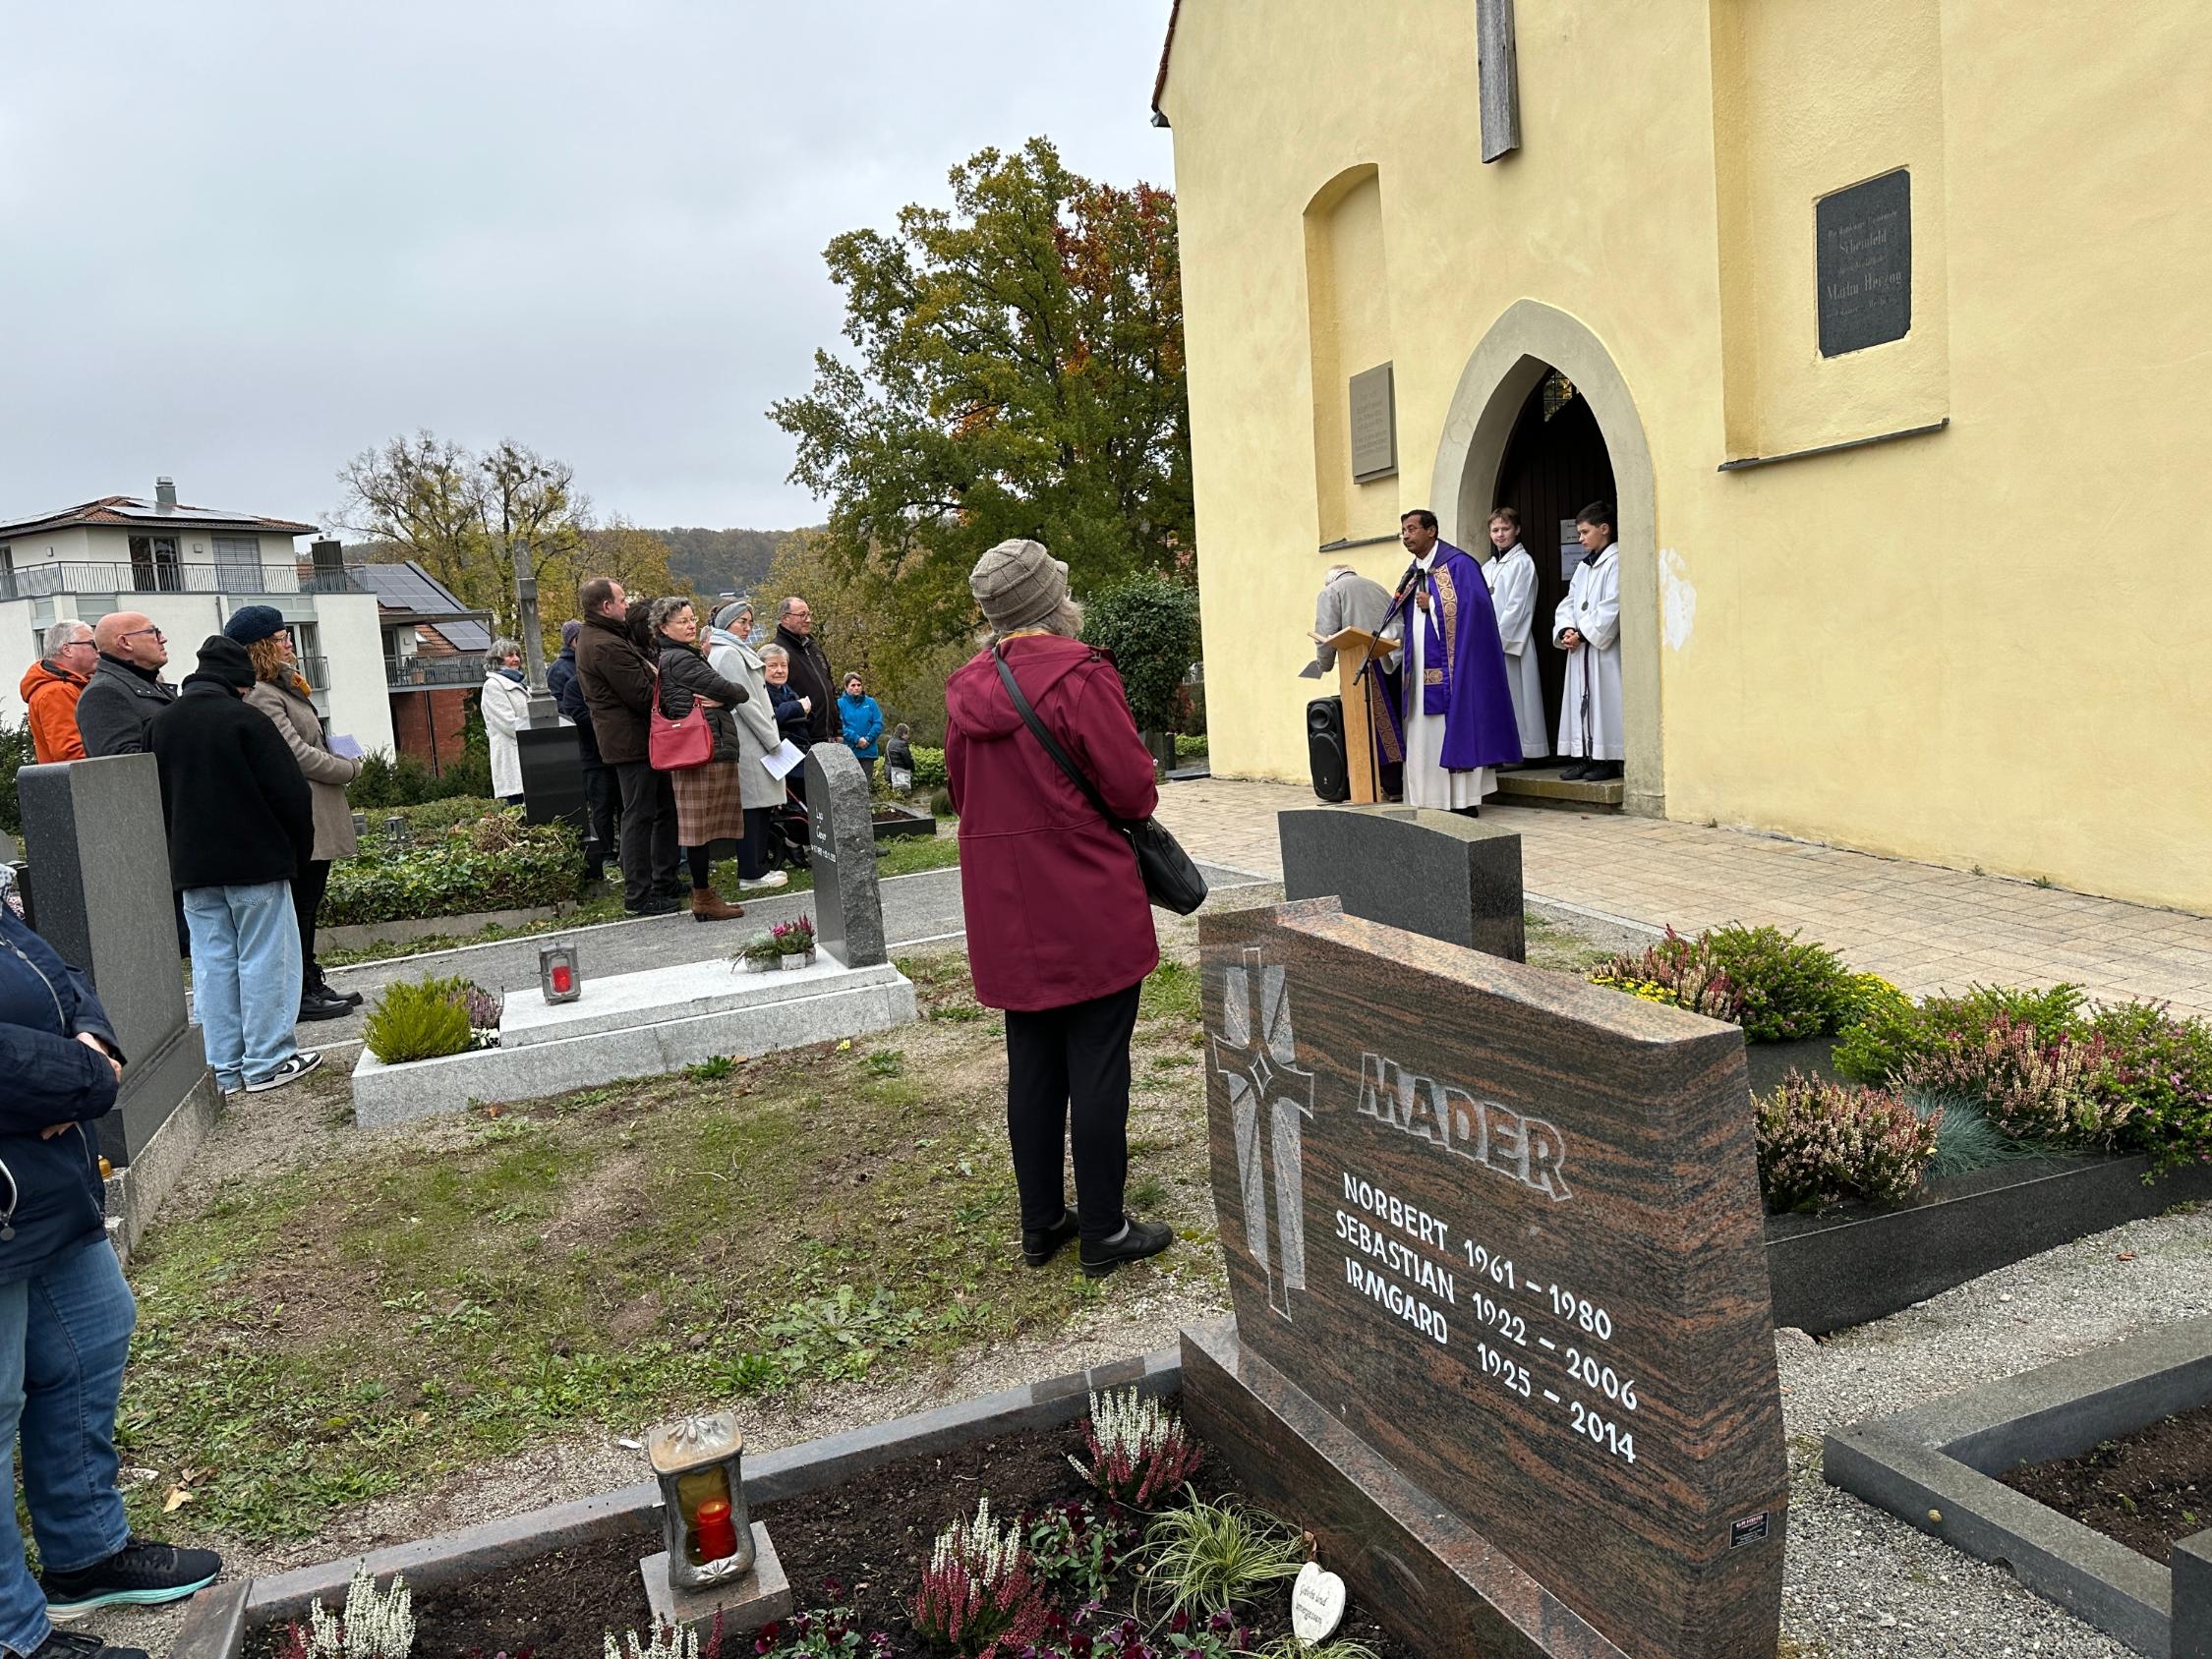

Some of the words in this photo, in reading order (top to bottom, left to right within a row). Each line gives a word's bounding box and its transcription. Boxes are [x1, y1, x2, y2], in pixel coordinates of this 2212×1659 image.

[1864, 270, 1902, 292] Herzog
[1357, 1053, 1573, 1202] MADER
[1336, 1210, 1455, 1304] SEBASTIAN
[1473, 1292, 1527, 1346] 1922
[1566, 1347, 1638, 1410] 2006
[1344, 1173, 1448, 1252] NORBERT
[1464, 1238, 1515, 1289] 1961
[1549, 1285, 1612, 1341] 1980
[1345, 1257, 1448, 1344] IRMGARD
[1477, 1343, 1531, 1398] 1925
[1571, 1402, 1636, 1464] 2014
